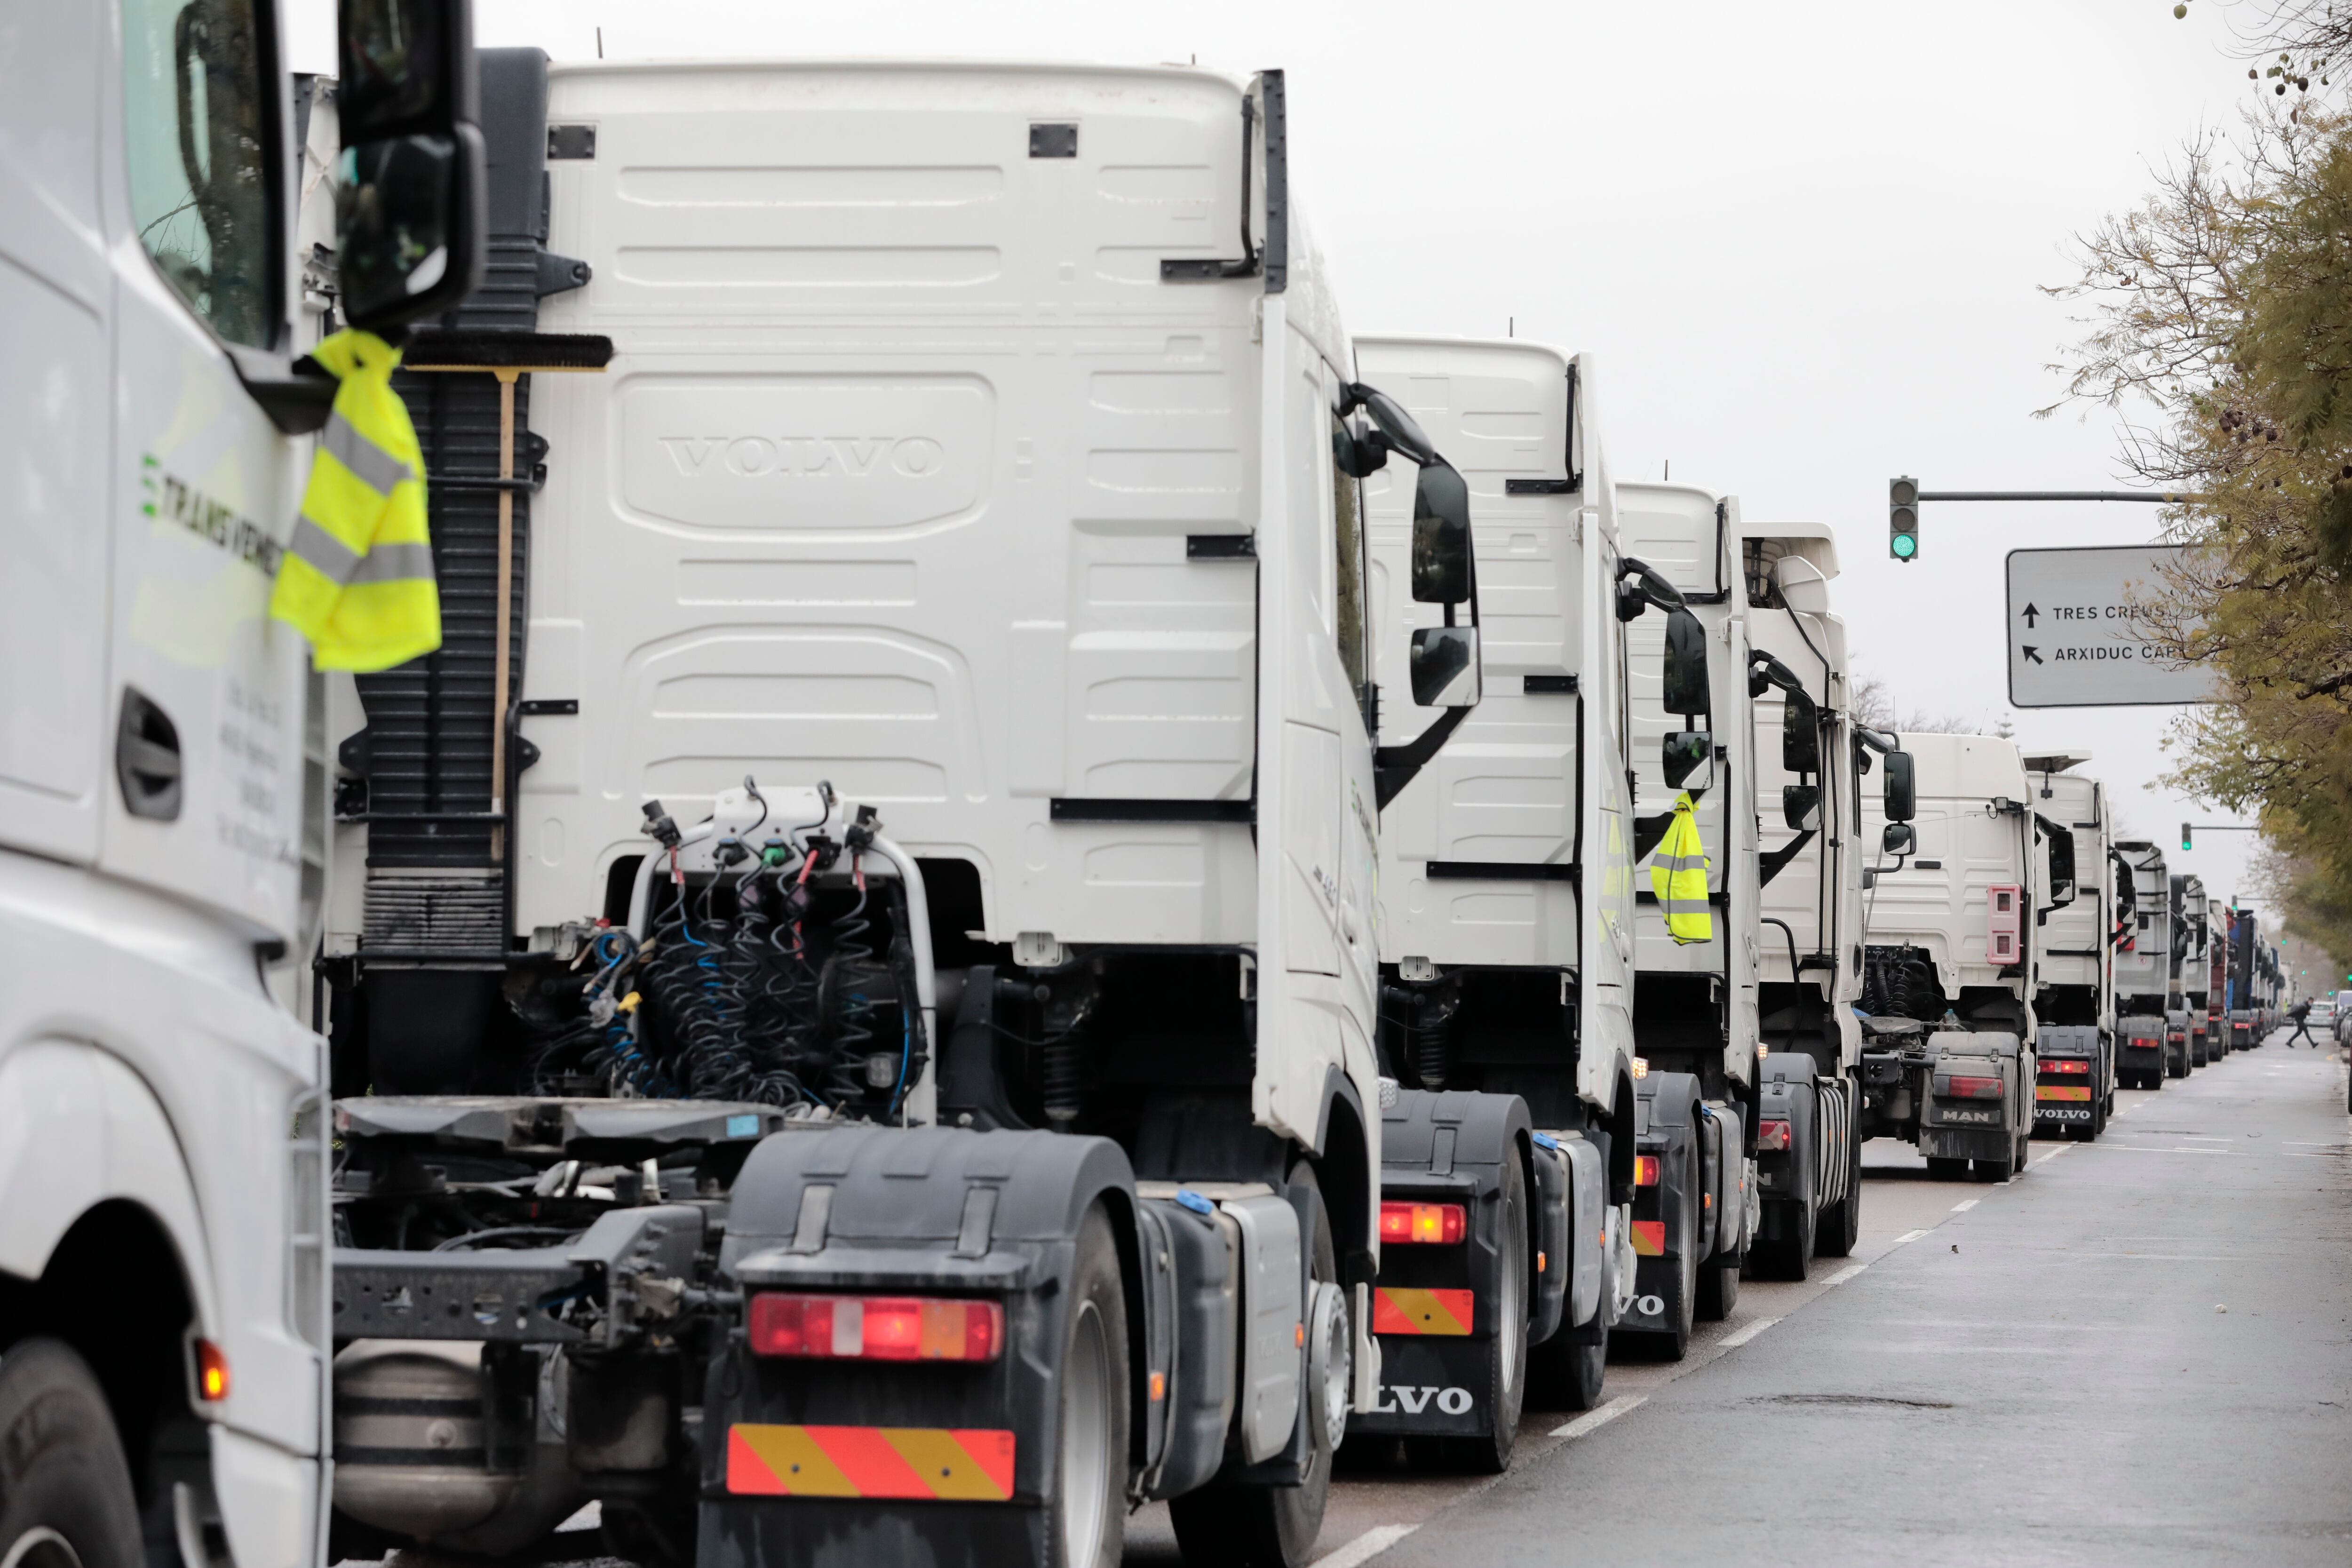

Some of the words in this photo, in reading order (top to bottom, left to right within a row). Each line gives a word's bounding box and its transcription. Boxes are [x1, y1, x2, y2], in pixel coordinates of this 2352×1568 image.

[658, 436, 943, 477] VOLVO
[2053, 607, 2098, 620] TRES
[2106, 606, 2165, 618] CREUS
[2055, 647, 2132, 660] ARXIDUC
[1943, 1110, 1989, 1122] MAN
[2034, 1109, 2091, 1120] VOLVO
